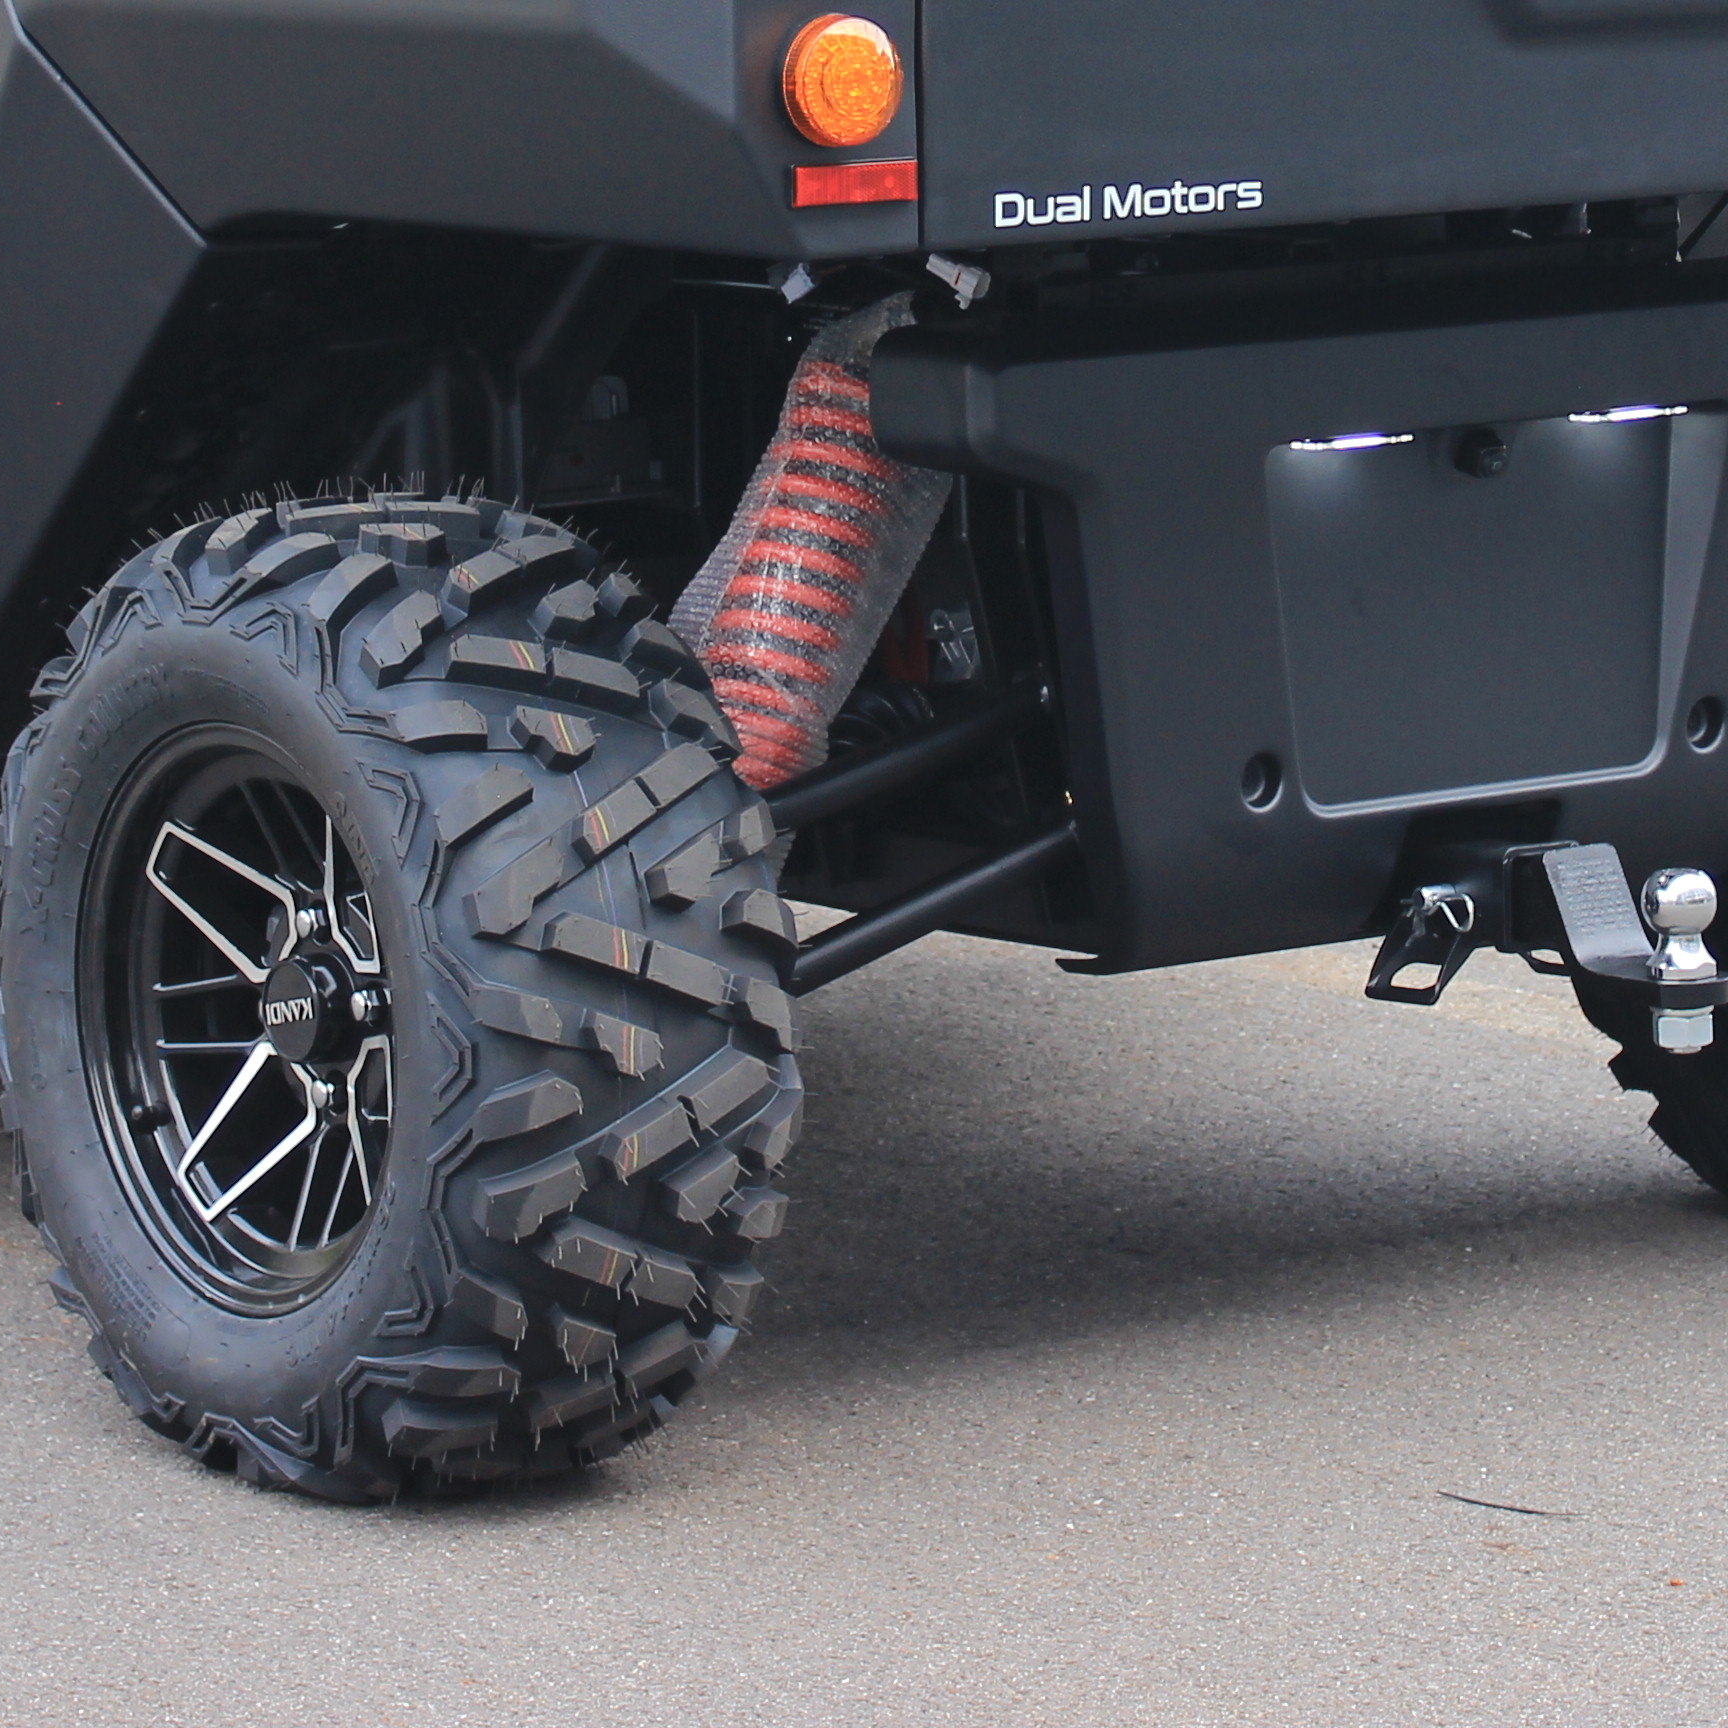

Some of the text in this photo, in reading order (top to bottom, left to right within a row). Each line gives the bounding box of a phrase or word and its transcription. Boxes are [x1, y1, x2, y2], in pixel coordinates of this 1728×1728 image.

[994, 179, 1263, 228] Dual Motors
[265, 997, 313, 1026] KANDI
